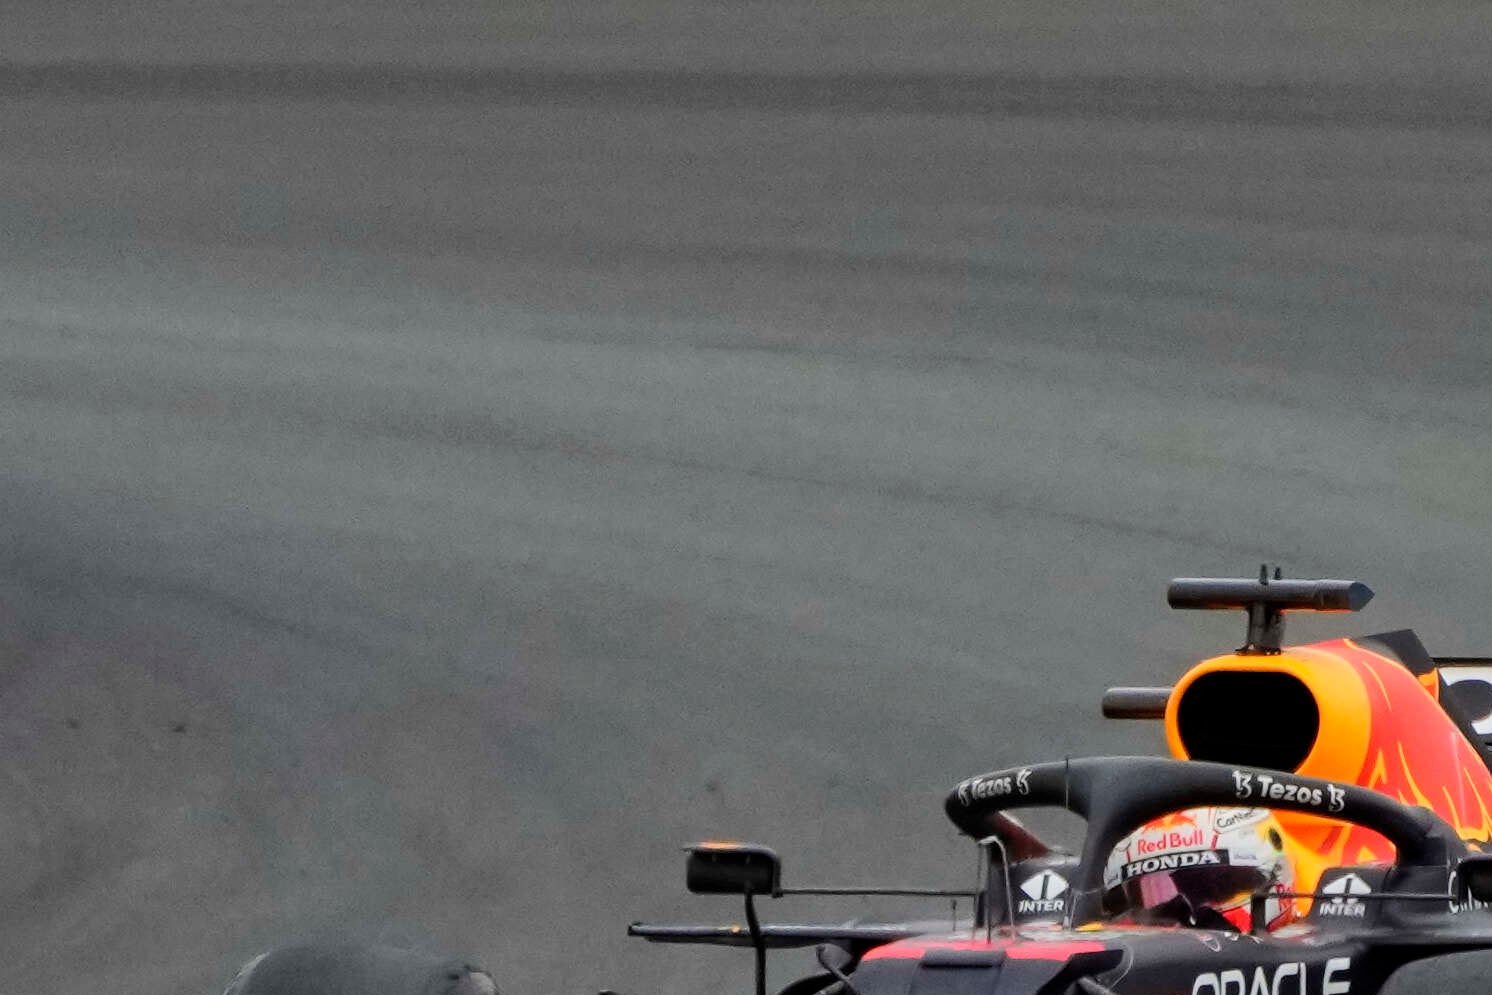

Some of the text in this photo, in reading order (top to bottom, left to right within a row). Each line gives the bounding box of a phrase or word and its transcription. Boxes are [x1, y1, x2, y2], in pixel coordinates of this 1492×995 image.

[971, 777, 1012, 800] Tezos
[1257, 775, 1323, 806] Tezos
[1137, 829, 1204, 857] Red Bull
[1127, 851, 1221, 879] HONDA
[1018, 899, 1065, 913] INTER
[1319, 902, 1366, 918] INTER
